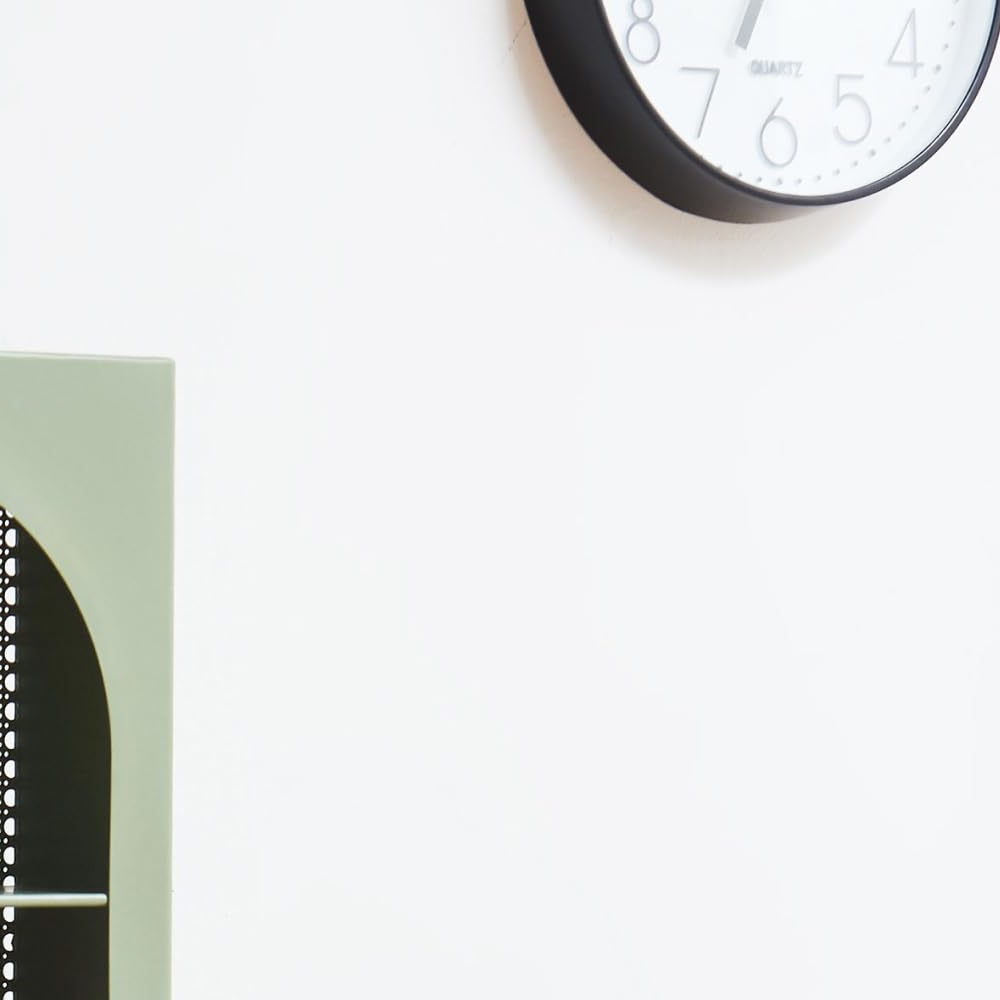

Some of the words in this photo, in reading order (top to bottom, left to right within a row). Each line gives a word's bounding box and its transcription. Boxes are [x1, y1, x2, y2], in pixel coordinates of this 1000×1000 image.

[625, 0, 661, 64] 8
[886, 8, 924, 78] 4
[679, 66, 720, 139] 7
[749, 60, 804, 77] QUARTZ
[759, 97, 798, 168] 6
[833, 74, 872, 144] 5
